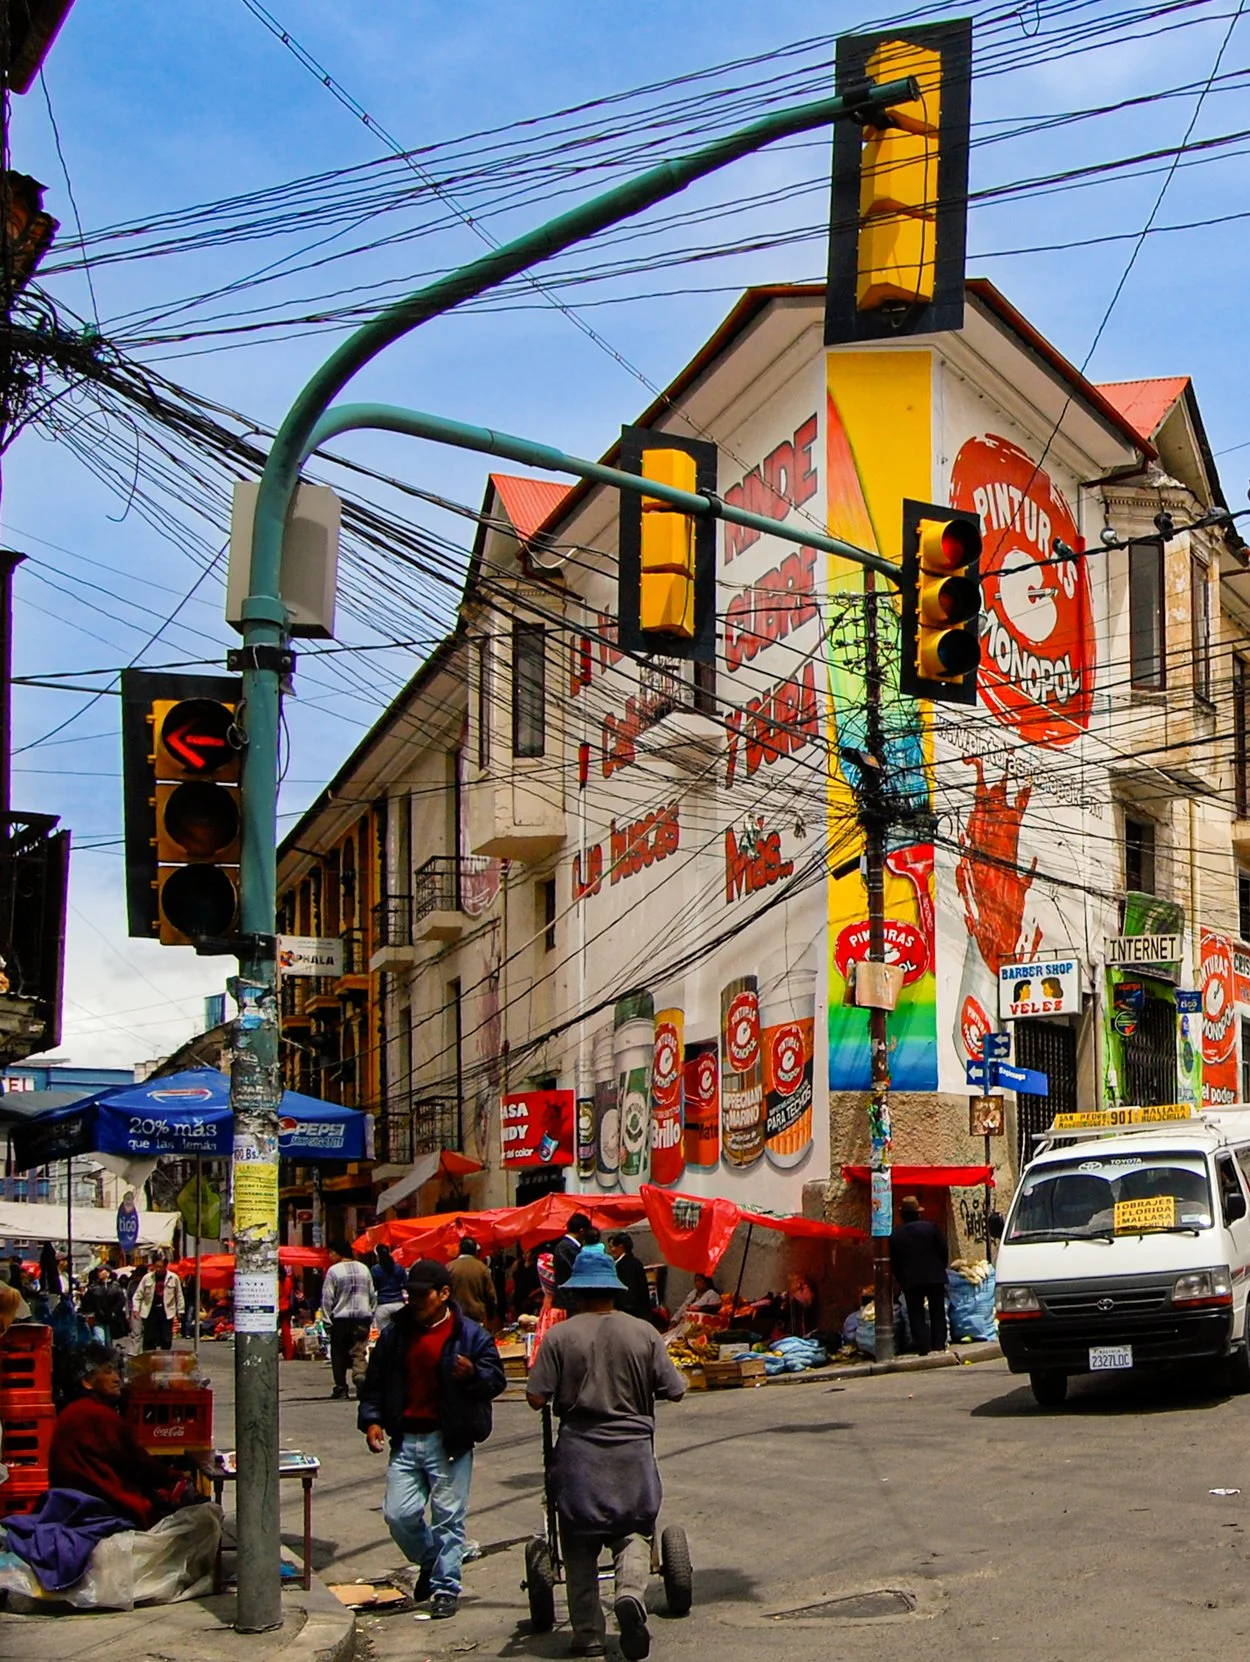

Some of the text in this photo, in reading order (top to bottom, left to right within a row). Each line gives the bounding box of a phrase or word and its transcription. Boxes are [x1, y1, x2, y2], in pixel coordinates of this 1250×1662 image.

[724, 411, 818, 567] RINDE
[745, 661, 819, 777] DURA
[848, 928, 915, 948] PINURAS
[1109, 936, 1176, 962] INTERNET
[1001, 962, 1073, 980] BARBER SHOP
[1010, 1000, 1063, 1015] VELEZ
[1202, 1084, 1209, 1099] el
[1211, 1087, 1235, 1104] poder
[767, 1111, 787, 1133] PARA
[786, 1085, 812, 1118] TECHOS
[129, 1117, 217, 1136] 20% más
[1111, 1112, 1132, 1125] 901
[295, 1123, 345, 1136] PEPSI
[651, 1117, 681, 1149] Brillo
[128, 1139, 150, 1149] que
[156, 1137, 174, 1149] las
[1122, 1199, 1172, 1211] OBRAJES
[1122, 1207, 1172, 1217] FLORIDA
[1122, 1214, 1172, 1224] MALLASA
